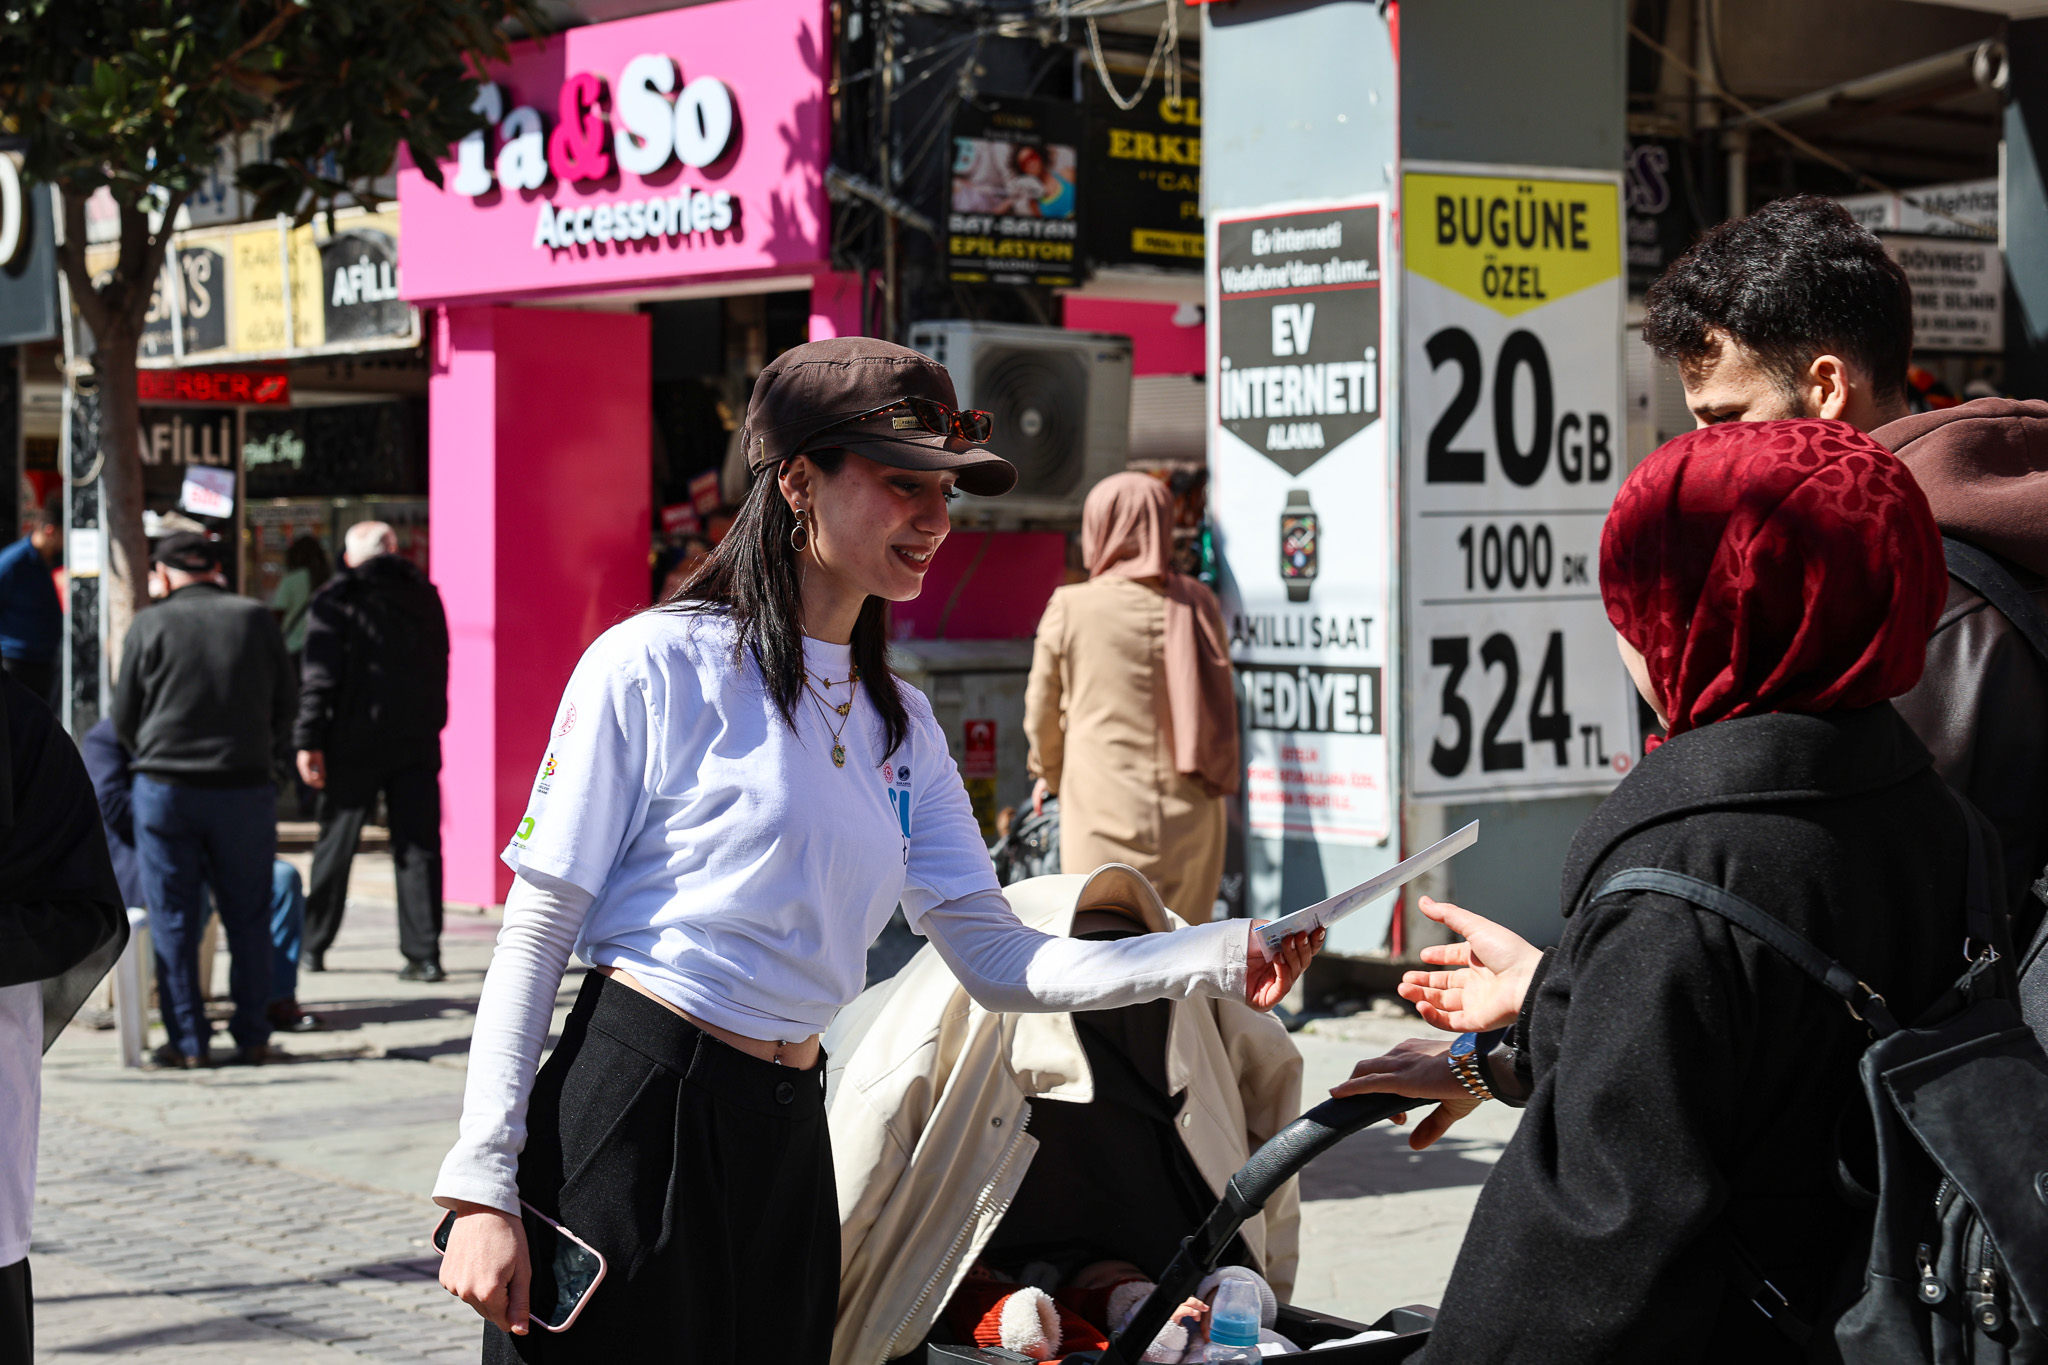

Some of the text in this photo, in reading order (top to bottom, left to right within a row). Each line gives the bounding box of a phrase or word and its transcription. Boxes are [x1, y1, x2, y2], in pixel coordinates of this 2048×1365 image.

[1159, 96, 1202, 126] CL
[1108, 129, 1202, 166] ERKE
[533, 185, 733, 249] Accessories
[1435, 184, 1589, 250] BUGÜNE
[332, 254, 398, 307] AFİLL
[1483, 254, 1546, 299] ÖZEL
[1272, 302, 1315, 356] EV
[1220, 346, 1377, 420] İNTERNETİ
[1266, 422, 1325, 450] ALANA
[1458, 522, 1589, 592] 1000 DK
[1231, 613, 1374, 649] AKILLI SAAT
